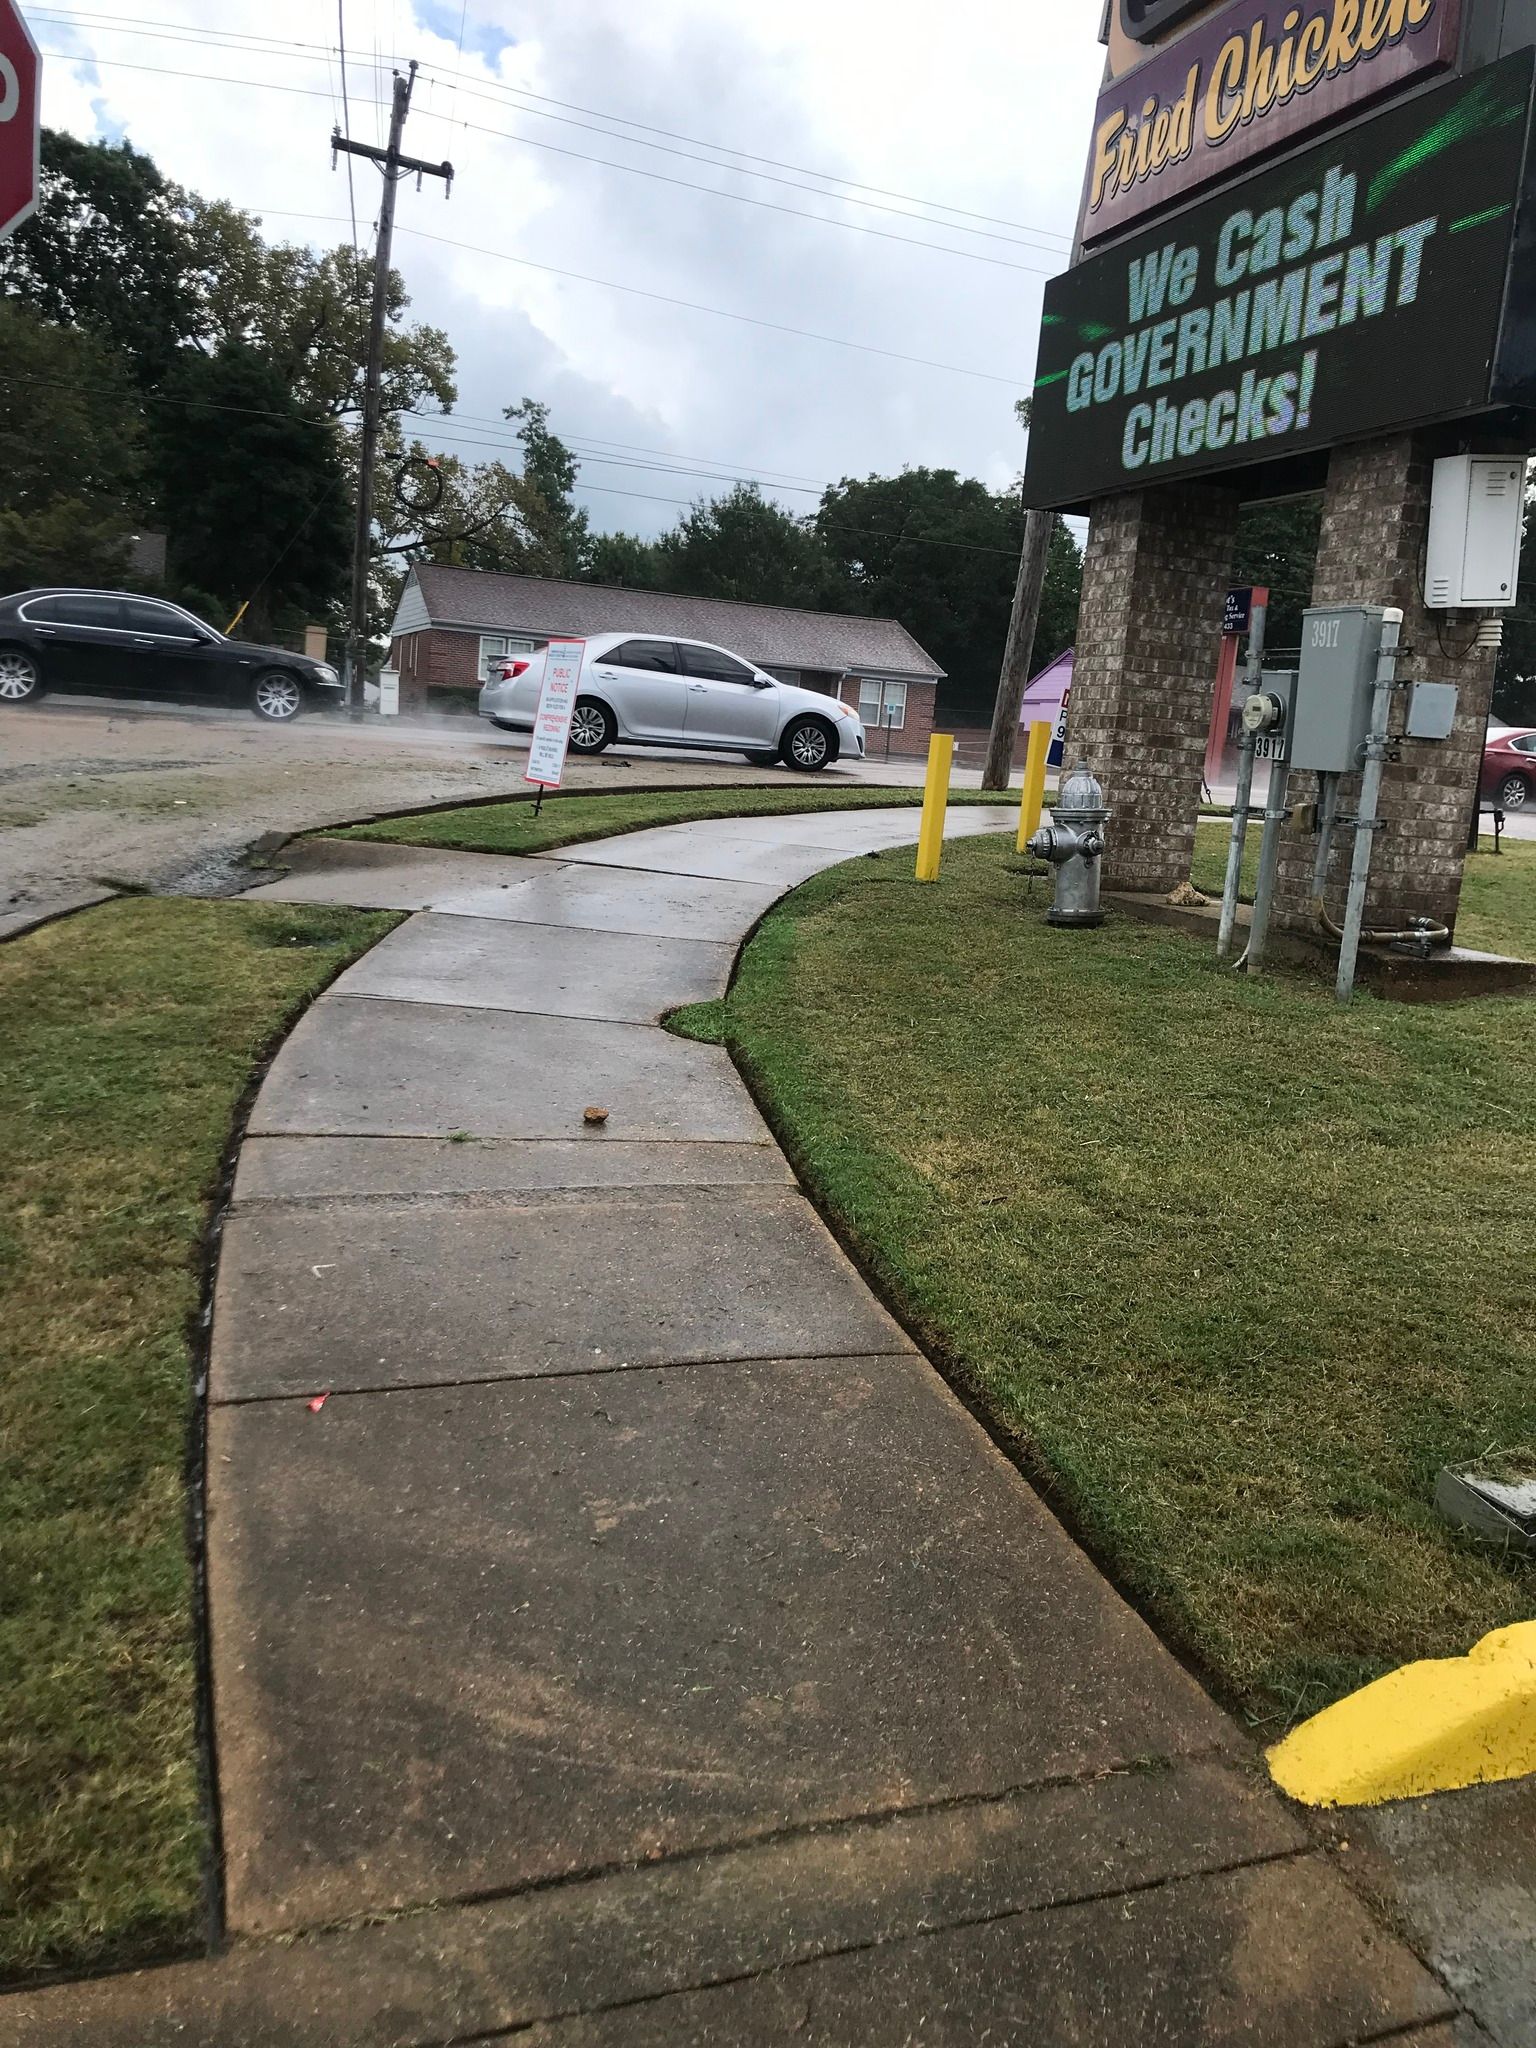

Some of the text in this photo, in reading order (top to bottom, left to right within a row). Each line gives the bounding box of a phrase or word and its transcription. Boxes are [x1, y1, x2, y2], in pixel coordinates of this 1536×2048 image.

[1090, 0, 1434, 208] Fried Chicken
[1066, 214, 1440, 414] GOVERNMENT
[1127, 163, 1358, 324] We Cash
[1121, 348, 1318, 470] Checks!
[1312, 620, 1341, 648] 3917
[1256, 737, 1285, 759] 3917
